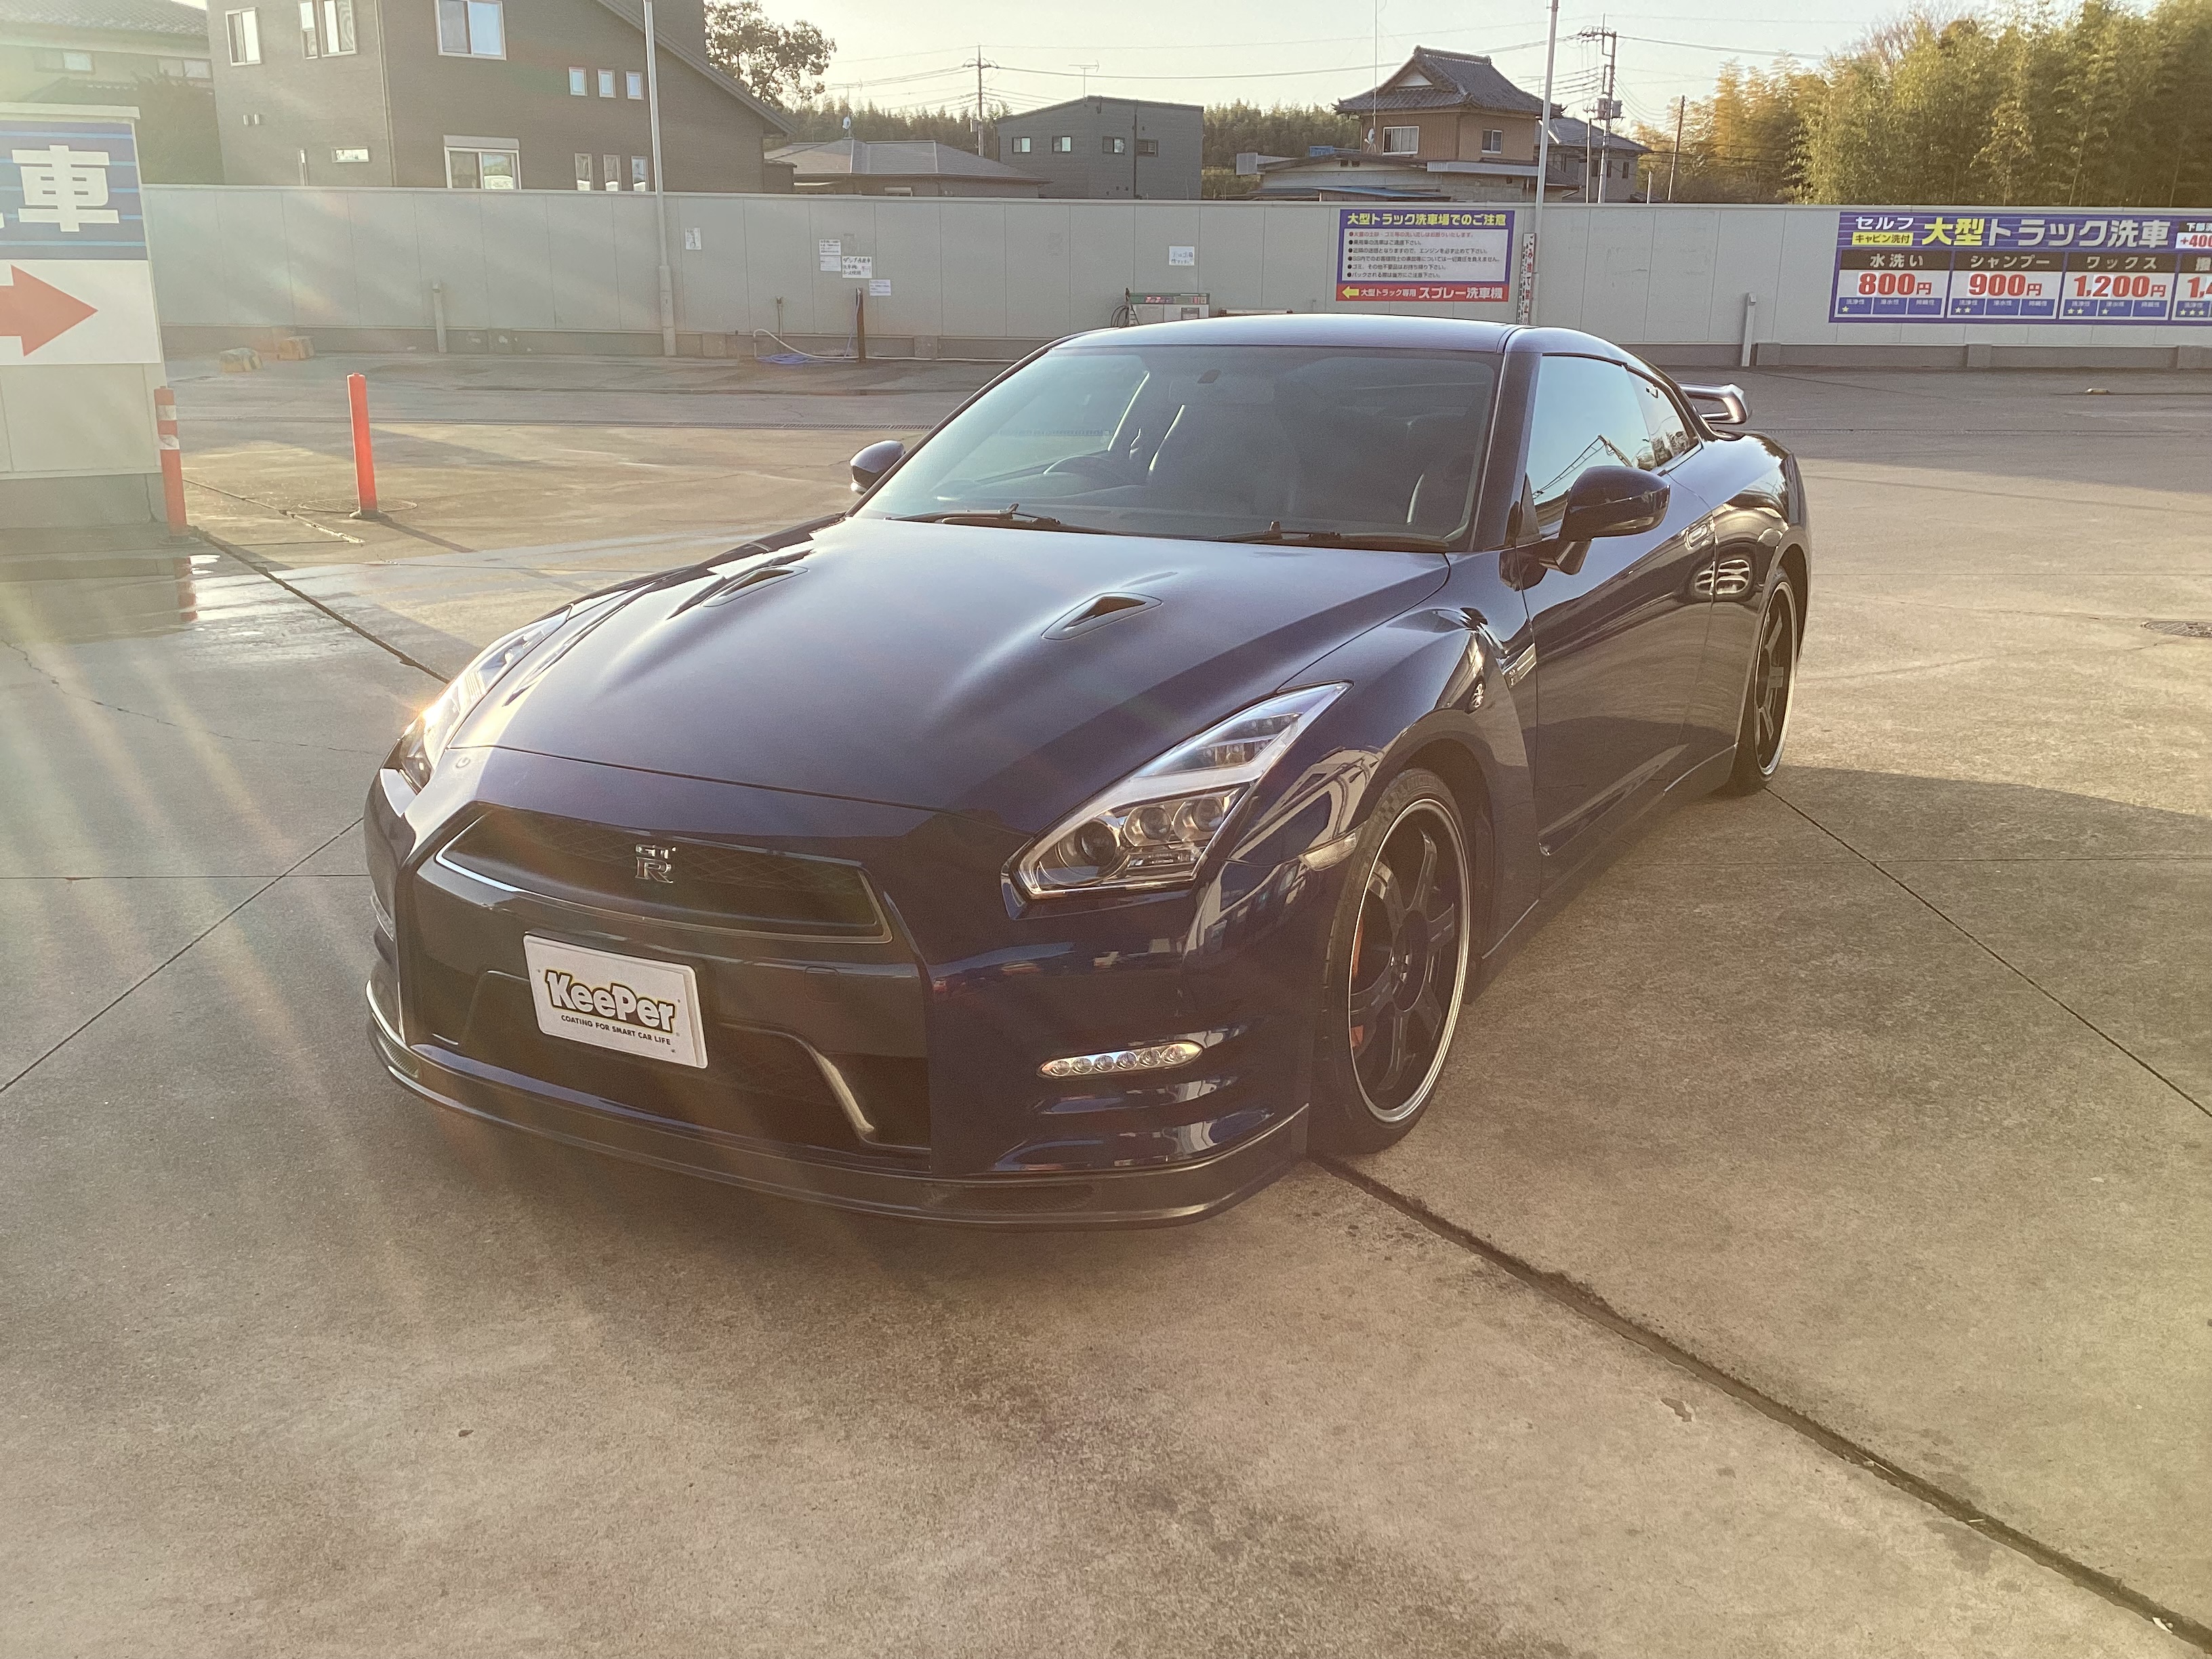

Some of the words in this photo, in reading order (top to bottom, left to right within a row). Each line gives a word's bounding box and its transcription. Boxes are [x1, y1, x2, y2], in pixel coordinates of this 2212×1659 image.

[0, 145, 120, 232] 車
[1347, 213, 1507, 226] 大型トラック洗車場でのご注意
[1856, 217, 1914, 230] セルフ
[1921, 217, 2171, 248] 大型トラック洗車
[1870, 253, 1923, 268] 水洗い
[1970, 254, 2050, 268] シャンプー
[2087, 256, 2157, 270] ワックス
[1360, 288, 1416, 297] 大型トラック専用
[1418, 287, 1502, 299] スプレー洗車機
[1858, 273, 1932, 295] 800円
[1969, 273, 2042, 296] 900円
[2074, 275, 2167, 298] 1,200円
[545, 969, 676, 1033] KeePer
[561, 1015, 593, 1027] COATING
[596, 1022, 610, 1031] FOR
[612, 1025, 636, 1037] SMART
[638, 1032, 652, 1041] CAR
[654, 1036, 671, 1045] LIFE
